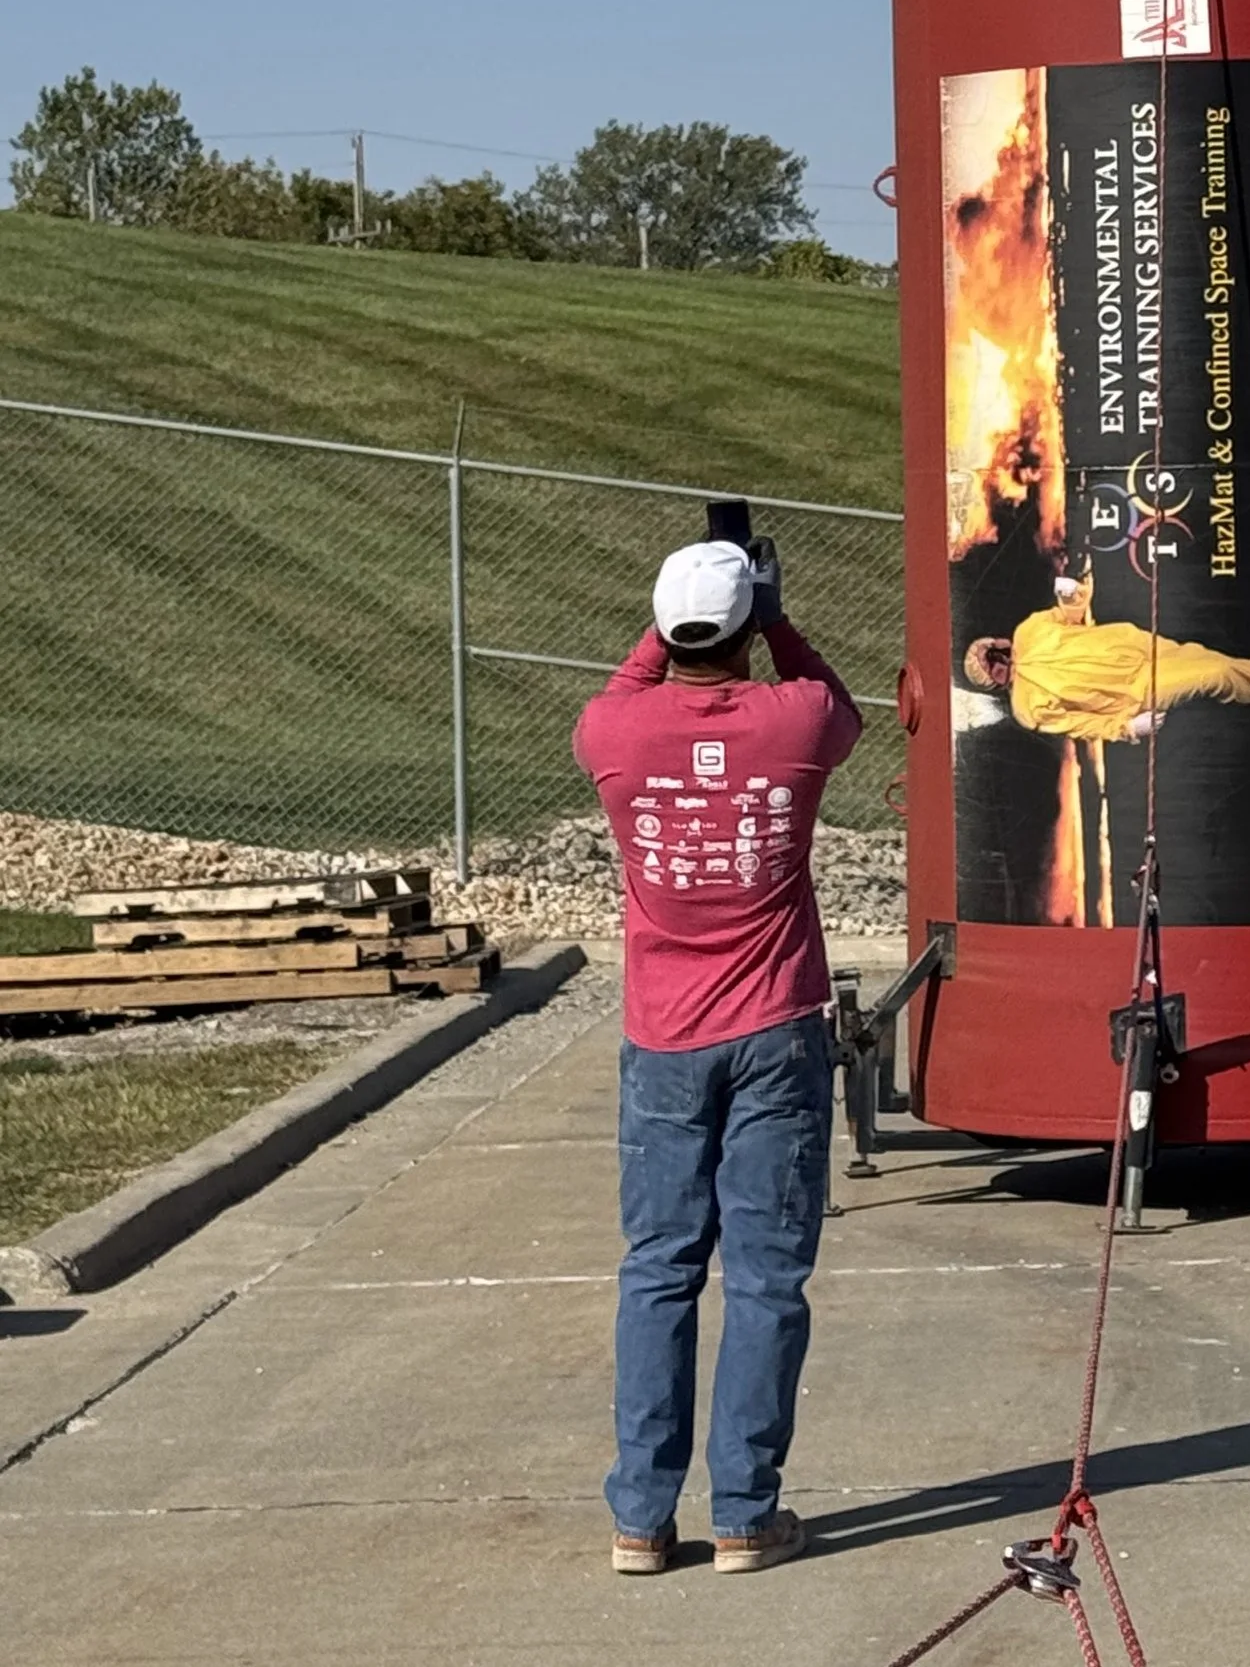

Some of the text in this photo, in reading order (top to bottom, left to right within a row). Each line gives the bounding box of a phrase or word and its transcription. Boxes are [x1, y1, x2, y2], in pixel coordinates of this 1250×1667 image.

[1094, 139, 1125, 435] ENVIRONMENTAL
[1131, 102, 1163, 435] TRAINING SERVICES
[1200, 107, 1236, 578] HazMat & Confined Space Training
